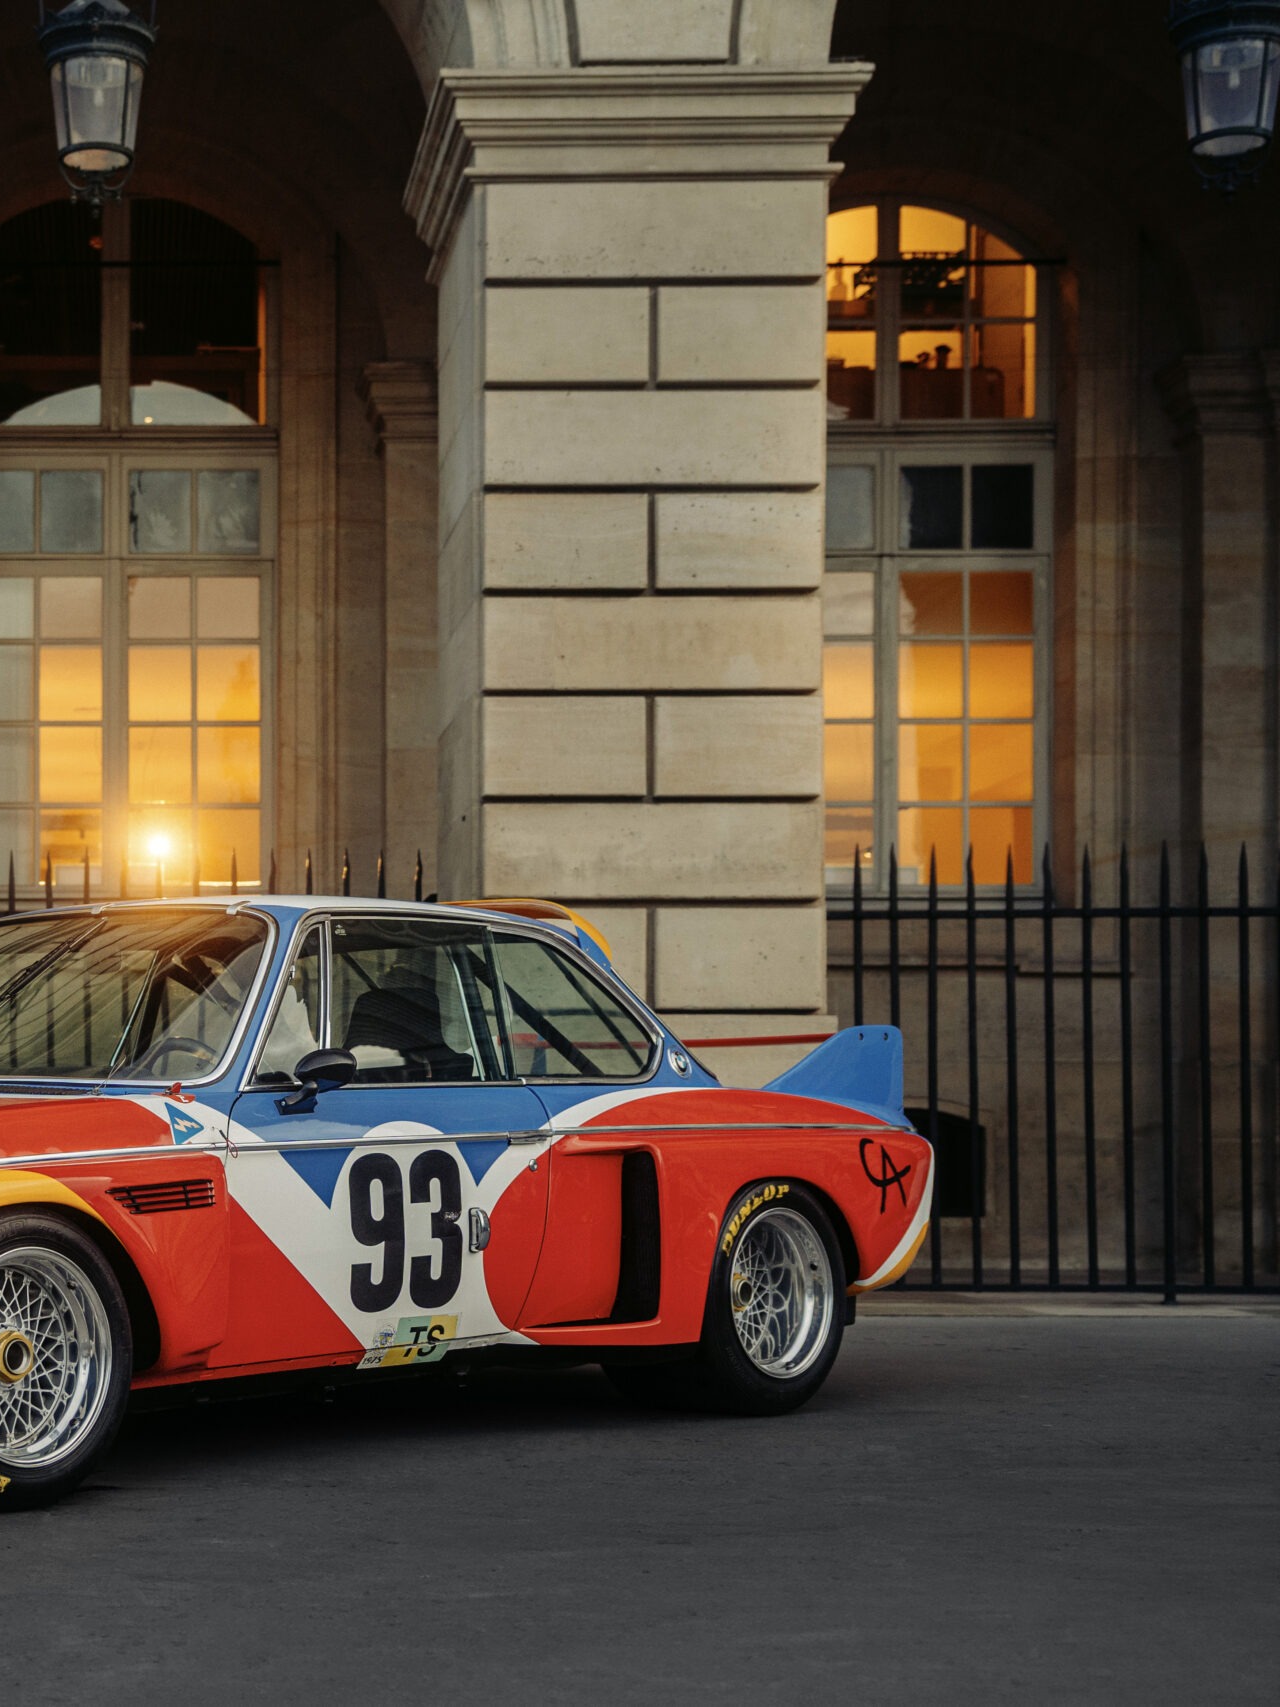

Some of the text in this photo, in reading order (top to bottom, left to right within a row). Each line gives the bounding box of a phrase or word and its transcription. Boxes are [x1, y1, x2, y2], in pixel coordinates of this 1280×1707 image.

[349, 1149, 463, 1313] 93
[722, 1184, 790, 1257] DUNLOP
[403, 1324, 445, 1357] TS
